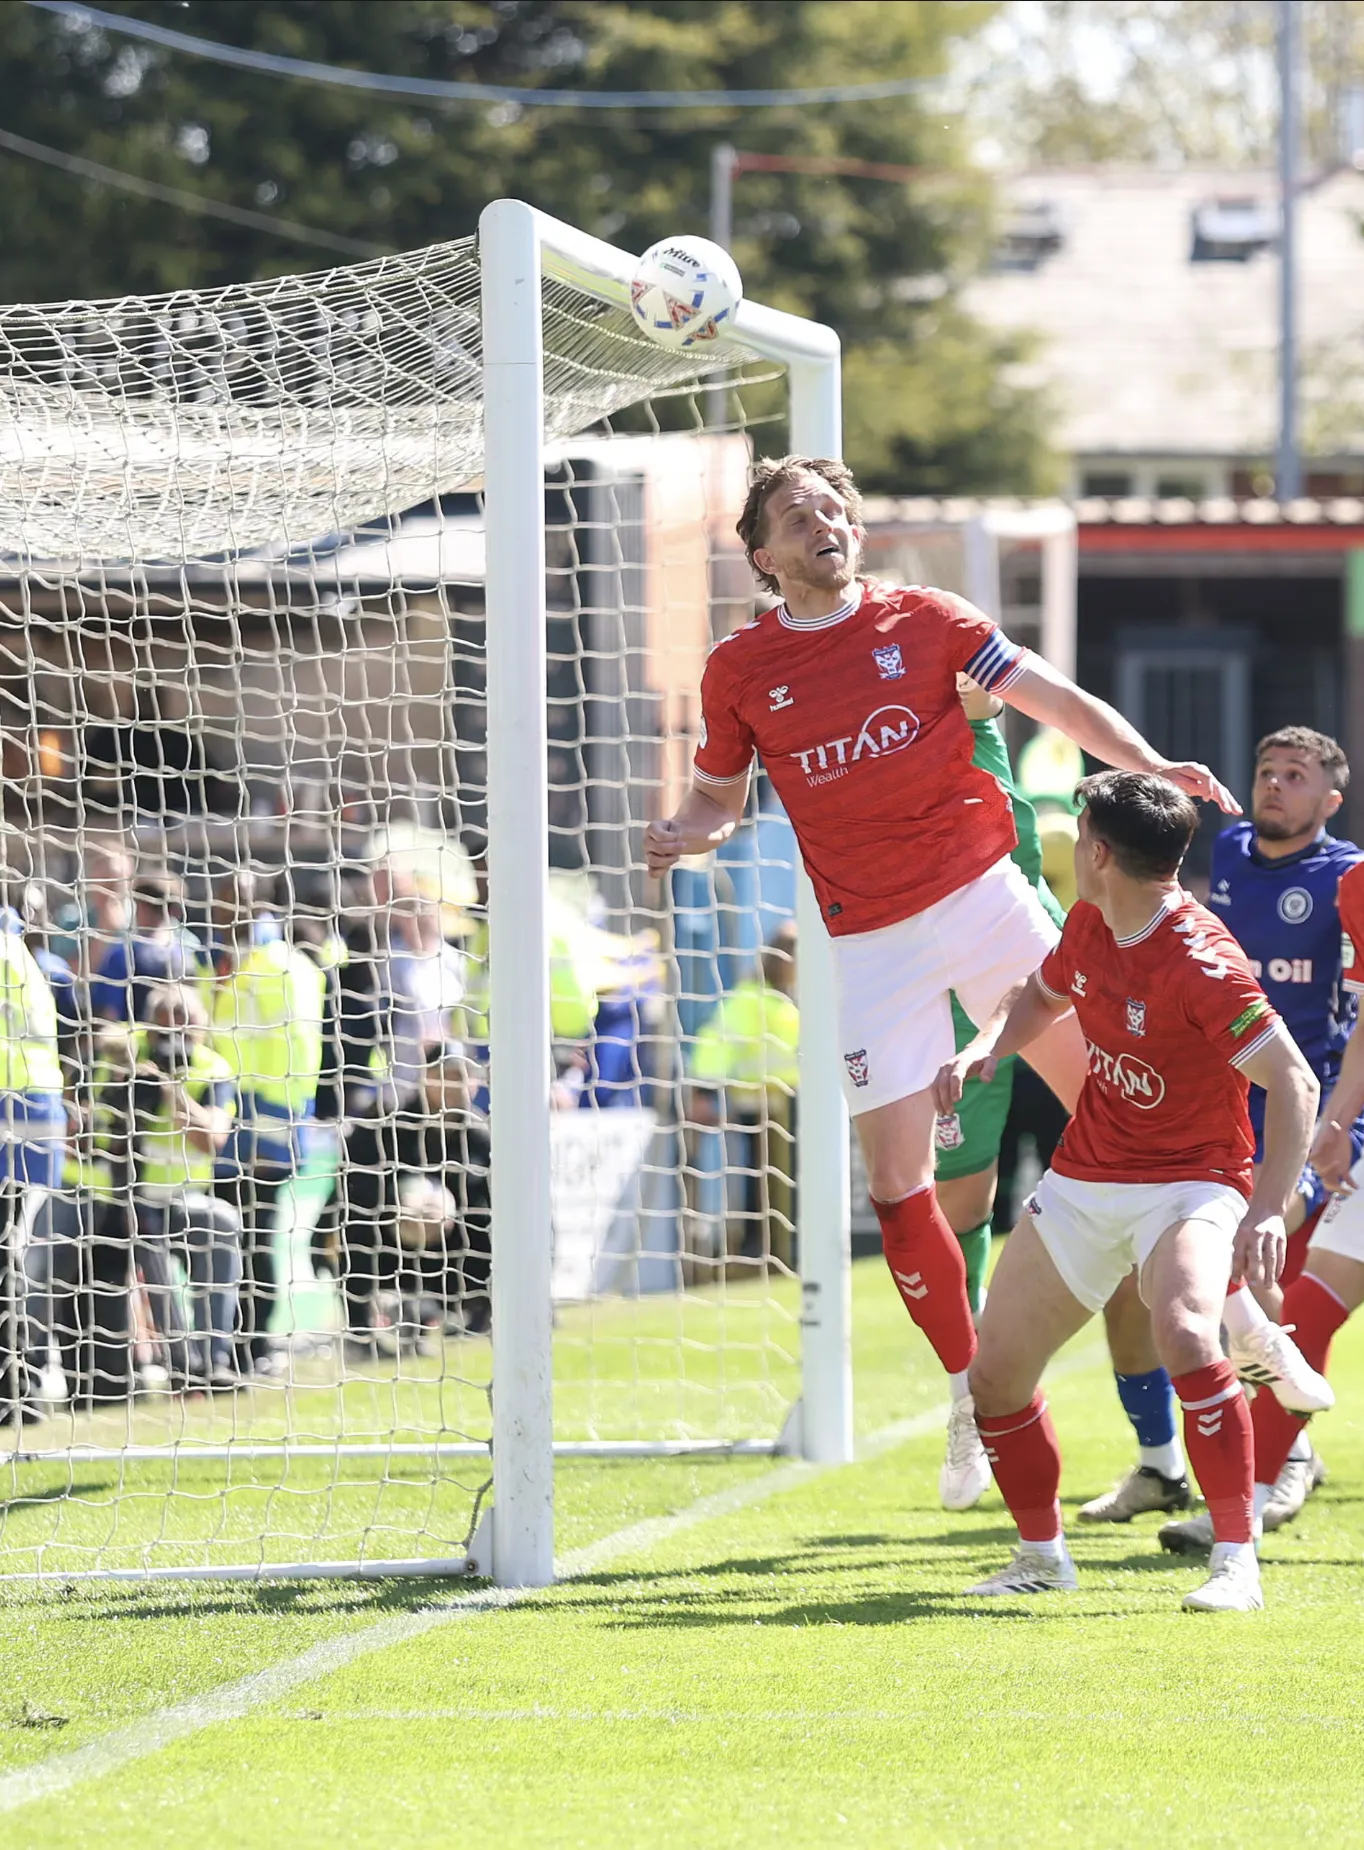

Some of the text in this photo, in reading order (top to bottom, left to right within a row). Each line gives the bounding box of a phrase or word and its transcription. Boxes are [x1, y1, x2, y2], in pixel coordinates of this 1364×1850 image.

[790, 720, 909, 774] TITAN
[806, 766, 849, 788] Wealth
[1268, 958, 1313, 983] Oil
